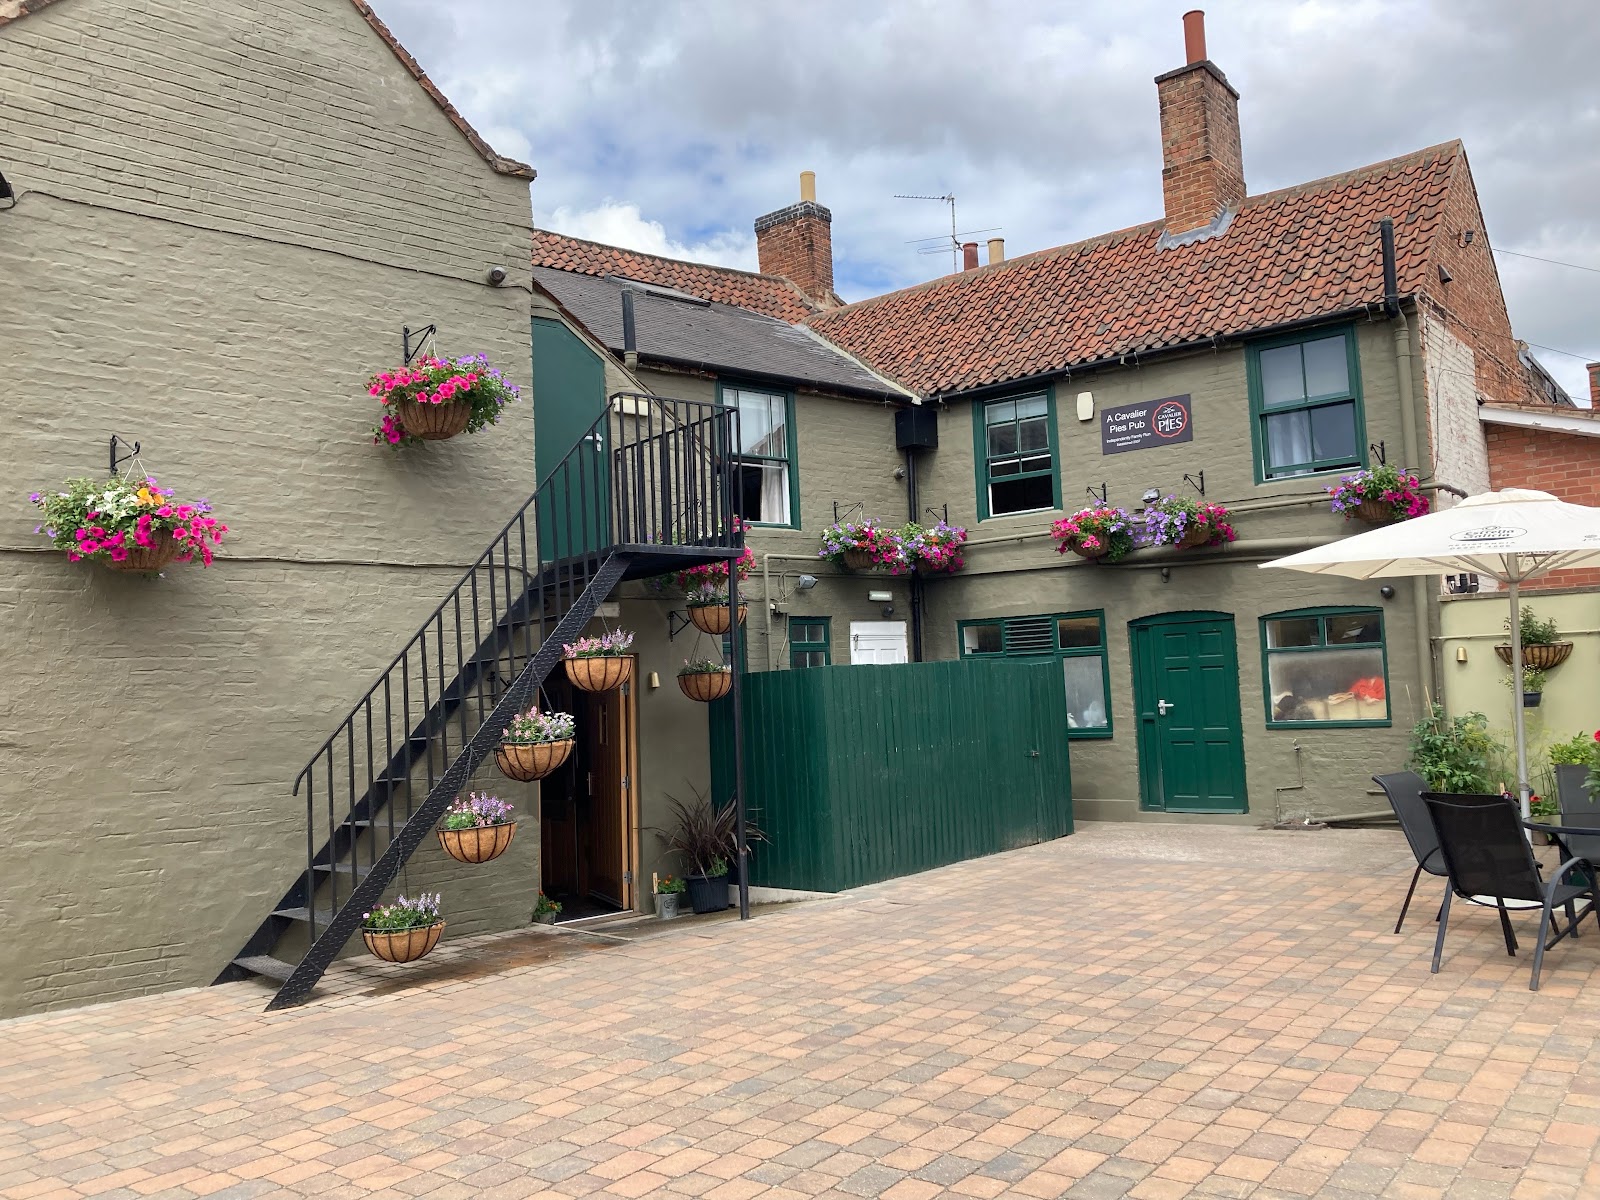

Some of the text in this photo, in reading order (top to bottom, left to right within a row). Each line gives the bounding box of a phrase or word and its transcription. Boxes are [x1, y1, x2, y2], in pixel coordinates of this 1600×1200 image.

[1106, 409, 1148, 424] A Cavalier
[1157, 411, 1182, 420] CAVALIER
[1109, 420, 1146, 434] Pies Pub
[1158, 417, 1183, 432] PIES
